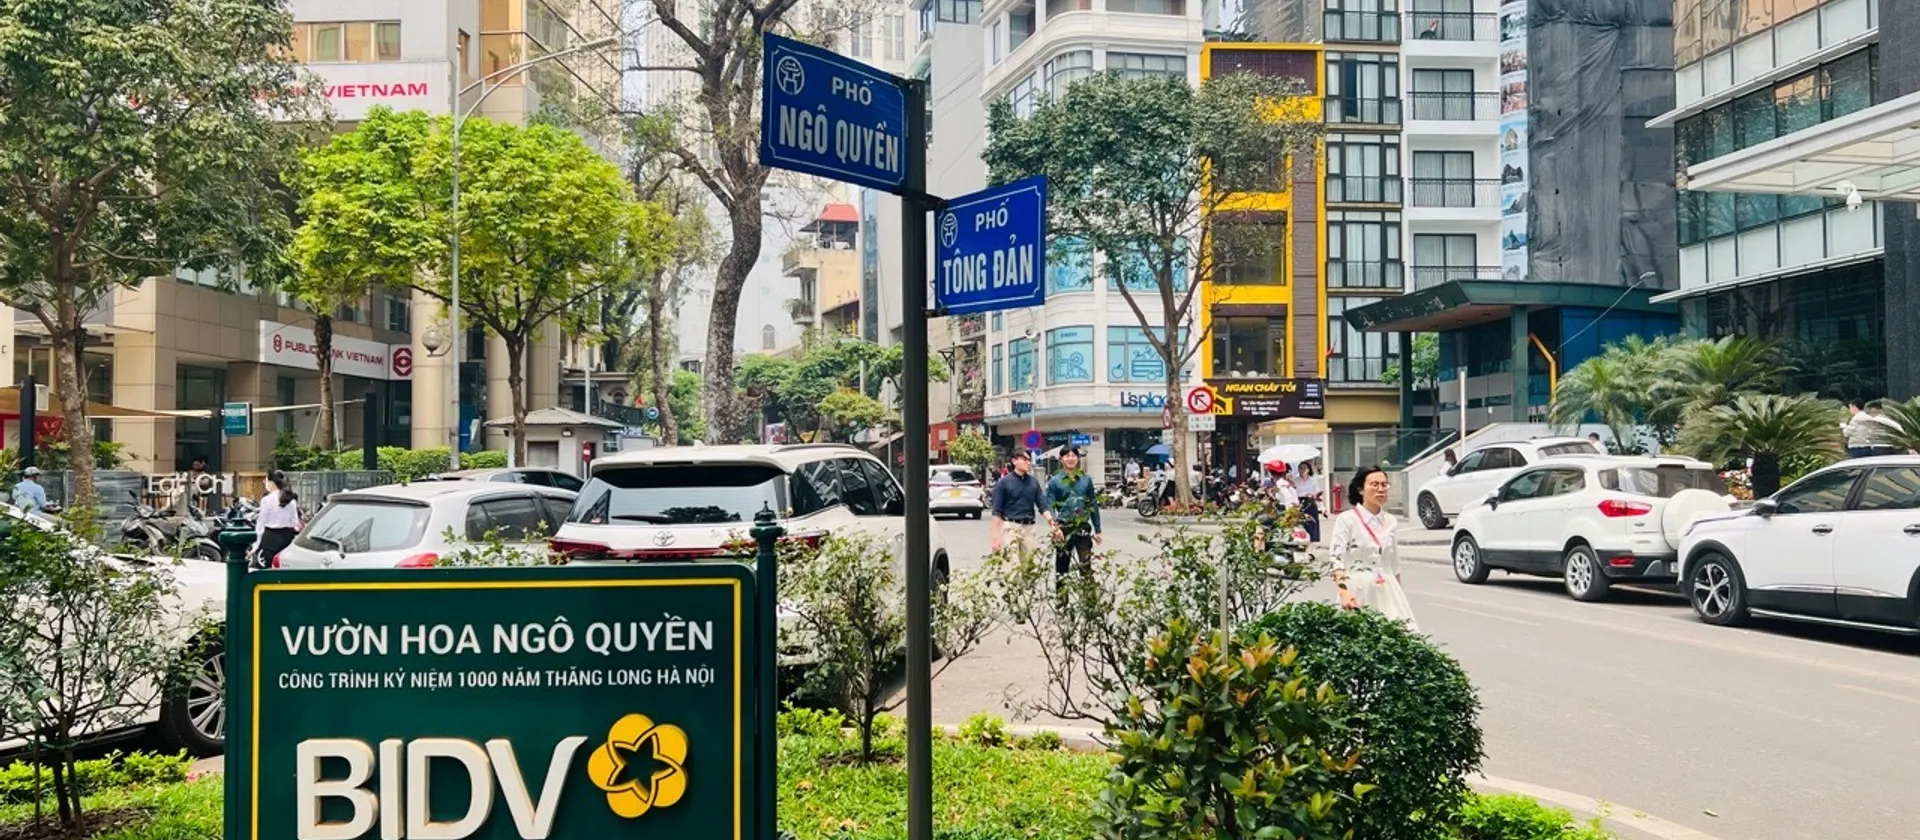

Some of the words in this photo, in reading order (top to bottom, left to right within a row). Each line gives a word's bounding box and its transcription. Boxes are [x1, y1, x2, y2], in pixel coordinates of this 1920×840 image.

[322, 83, 428, 98] VIETNAM
[831, 76, 875, 106] PHỐ
[779, 104, 828, 155] NGÔ
[835, 119, 899, 173] QUYỀN
[975, 198, 1010, 232] PHỐ
[943, 248, 987, 296] TÔNG
[993, 233, 1033, 289] ĐẢN
[346, 352, 383, 366] VIETNAM
[281, 617, 388, 656] VƯỜN
[401, 623, 482, 656] HOA
[493, 615, 576, 656] NGÔ
[585, 611, 714, 657] QUYỀN
[278, 668, 325, 689] CÔNG
[328, 668, 380, 689] TRÌNH
[410, 667, 453, 691] NIỆM
[458, 671, 499, 688] 1000
[502, 666, 541, 687] NĂM
[545, 666, 604, 687] THĂNG
[608, 669, 652, 686] LONG
[657, 665, 682, 685] HÀ
[685, 663, 714, 688] NỘI
[296, 735, 589, 840] BIDV
